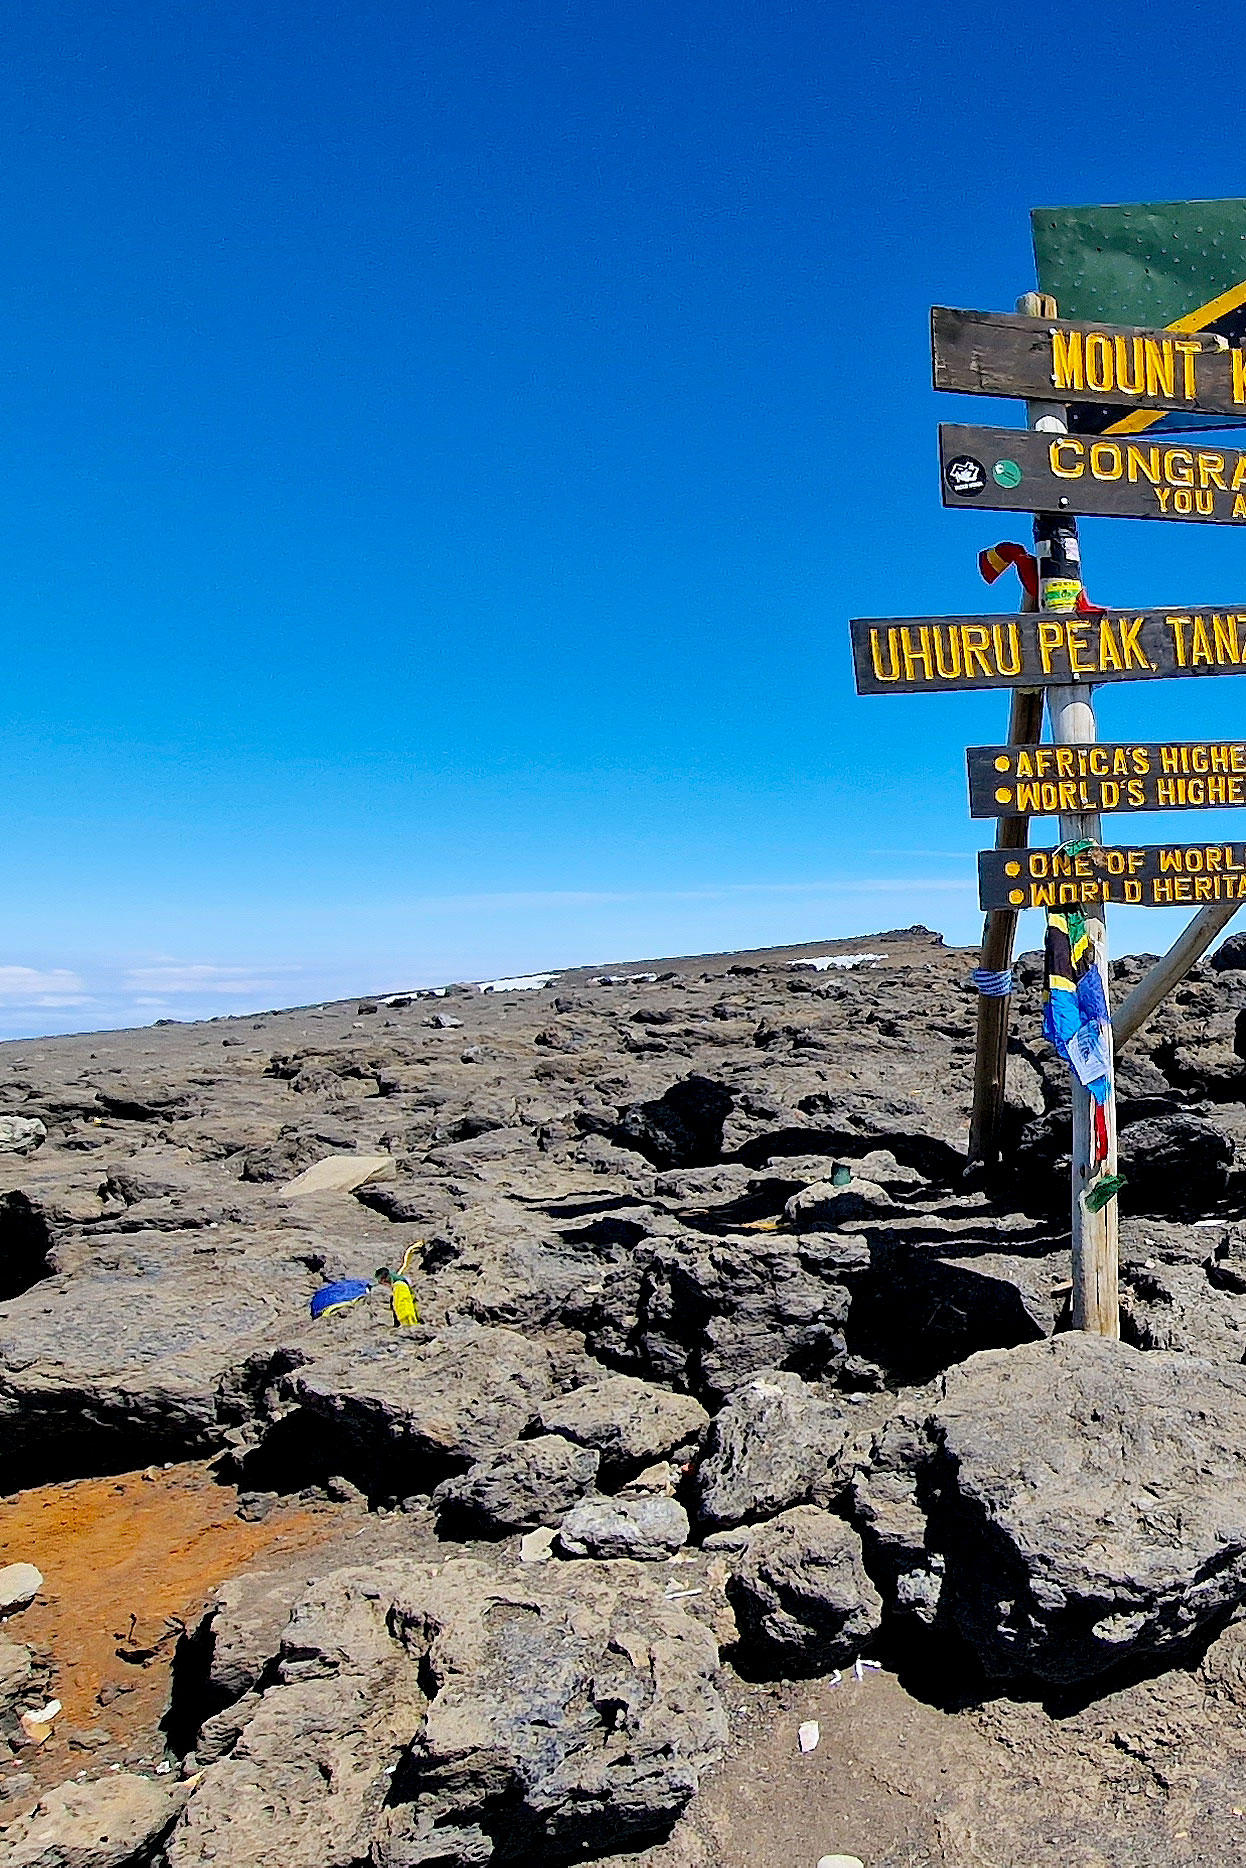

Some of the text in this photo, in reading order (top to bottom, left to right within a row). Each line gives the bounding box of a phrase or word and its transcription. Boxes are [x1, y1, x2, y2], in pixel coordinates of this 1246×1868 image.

[1051, 330, 1202, 399] MOUNT
[1153, 487, 1214, 516] YOU
[869, 622, 1021, 682] UHURU
[1038, 617, 1158, 674] PEAK,
[1016, 747, 1150, 778] AFRICA'S
[1016, 778, 1146, 812] WORLD'S
[1029, 850, 1094, 878] ONE
[1107, 849, 1146, 875] OF
